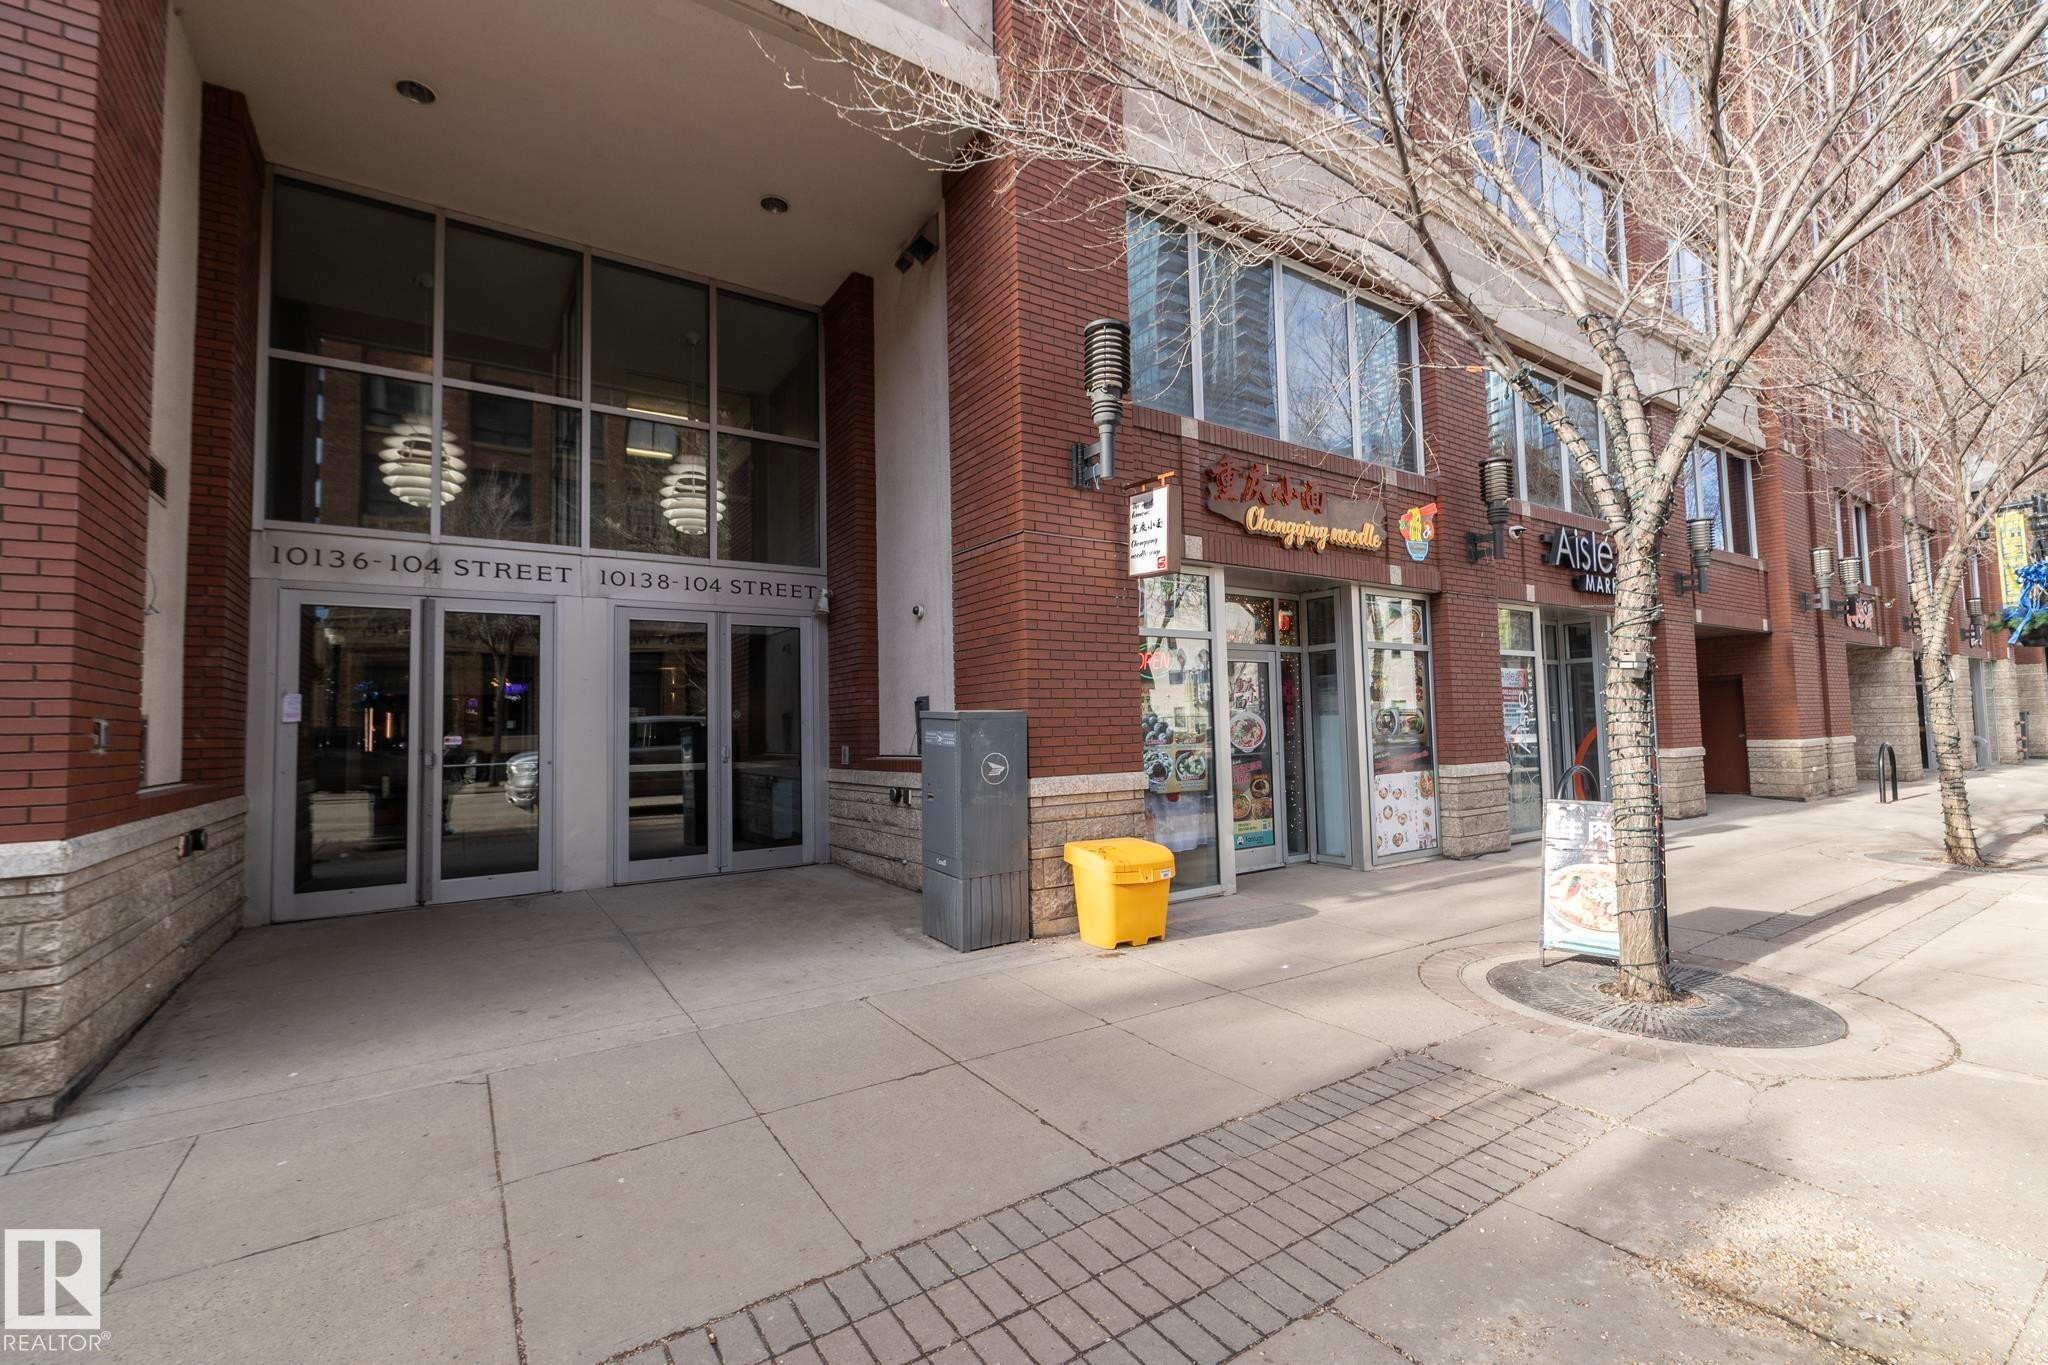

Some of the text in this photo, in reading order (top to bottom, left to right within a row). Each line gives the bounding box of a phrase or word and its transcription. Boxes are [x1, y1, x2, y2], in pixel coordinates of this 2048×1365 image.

[1245, 505, 1383, 550] Chongqing noodle
[271, 546, 572, 583] 10136-104 STREET
[600, 569, 818, 600] 10138-104 STREET
